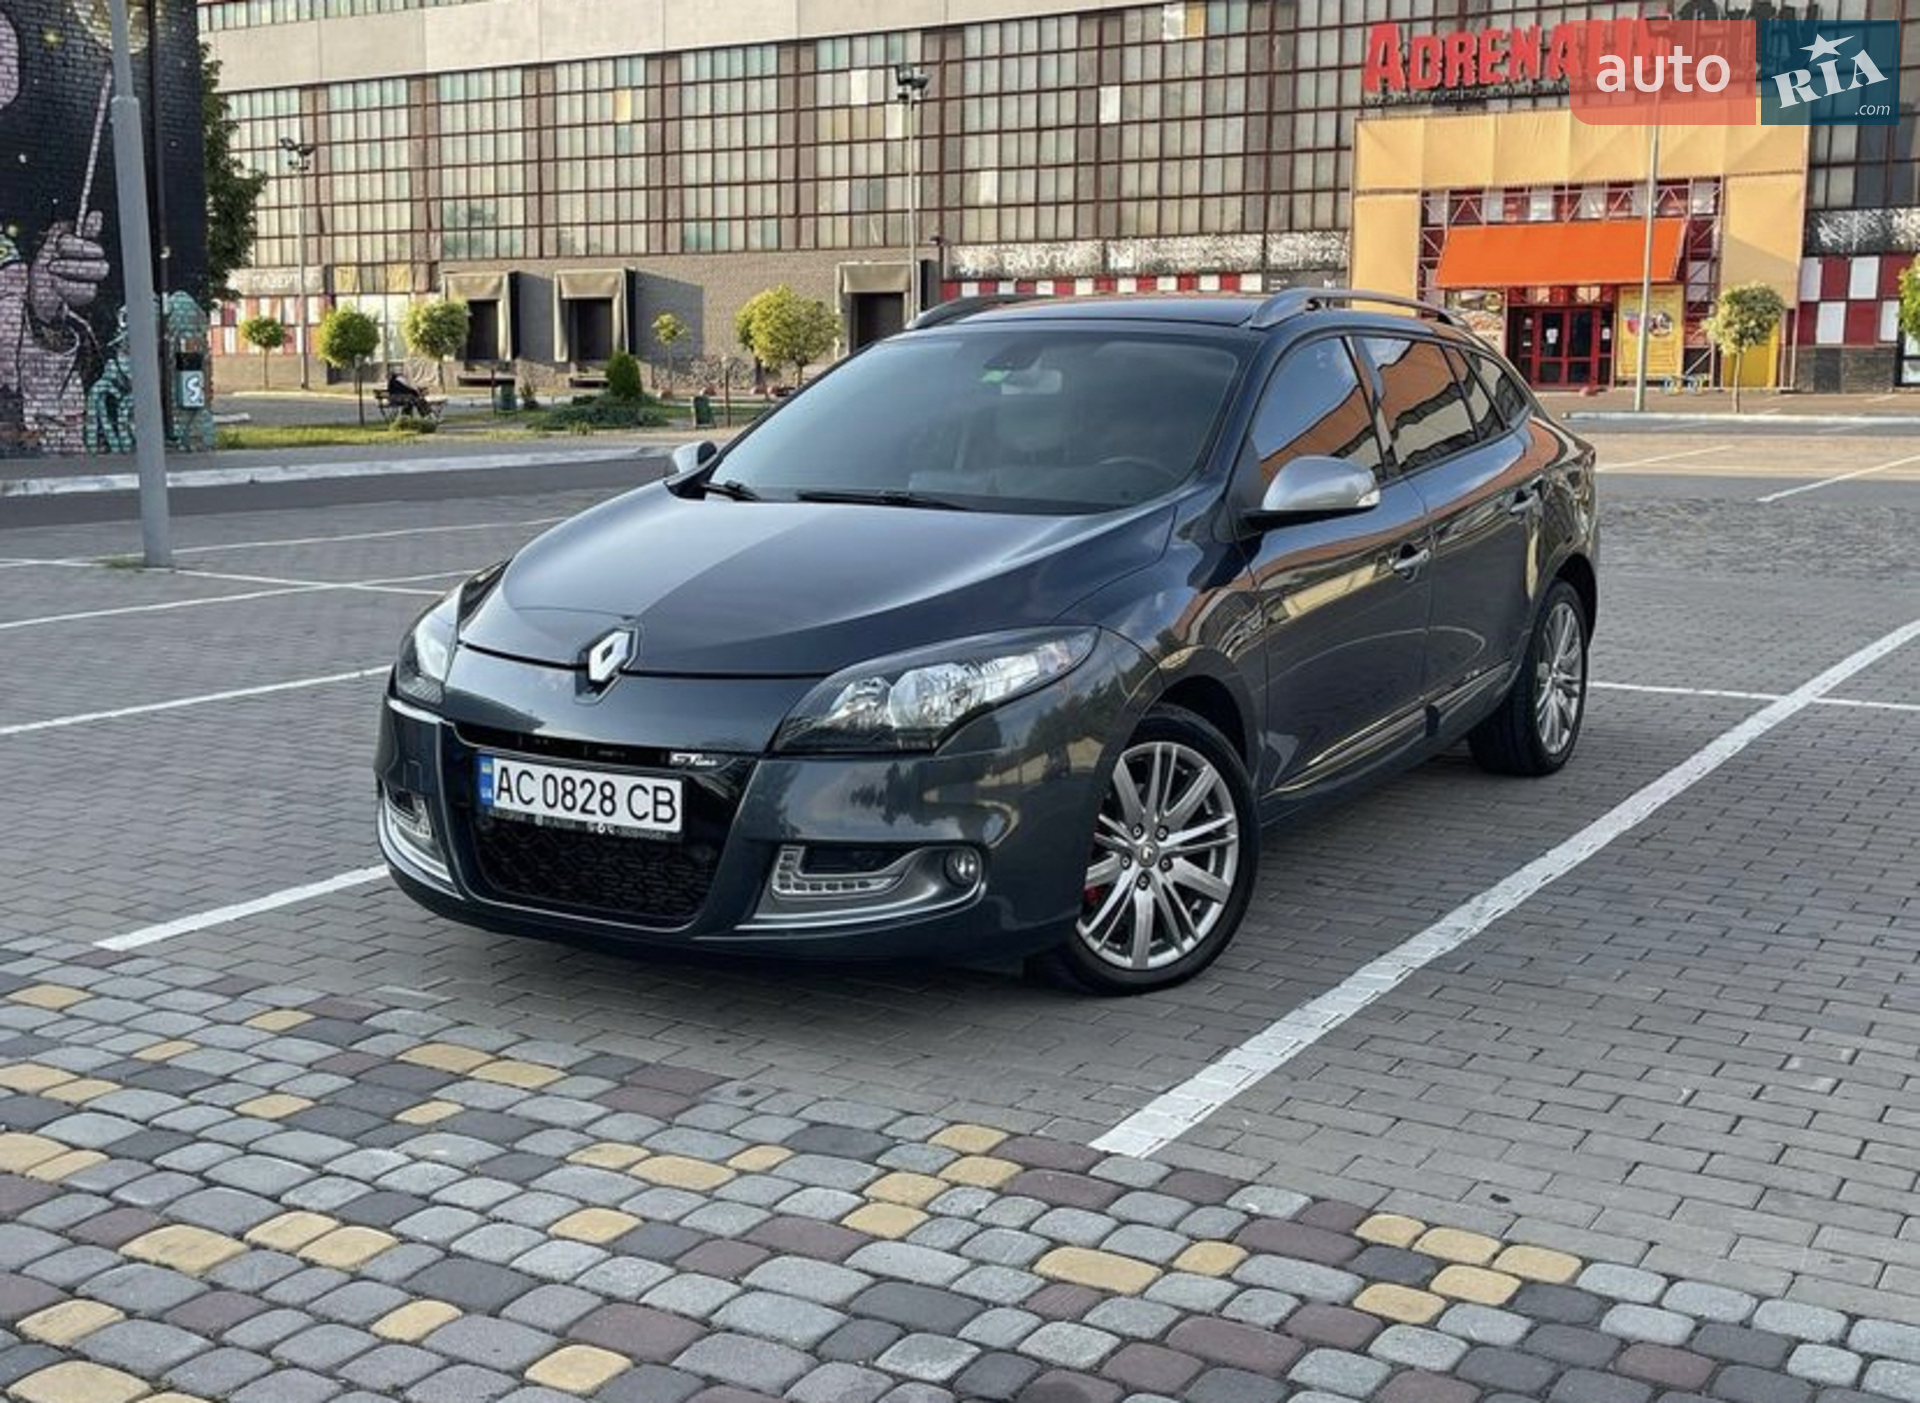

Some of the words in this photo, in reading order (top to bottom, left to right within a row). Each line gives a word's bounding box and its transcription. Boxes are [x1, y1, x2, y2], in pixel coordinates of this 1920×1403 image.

[496, 766, 535, 806] AC
[542, 773, 617, 817] 0828
[626, 783, 677, 825] CB
